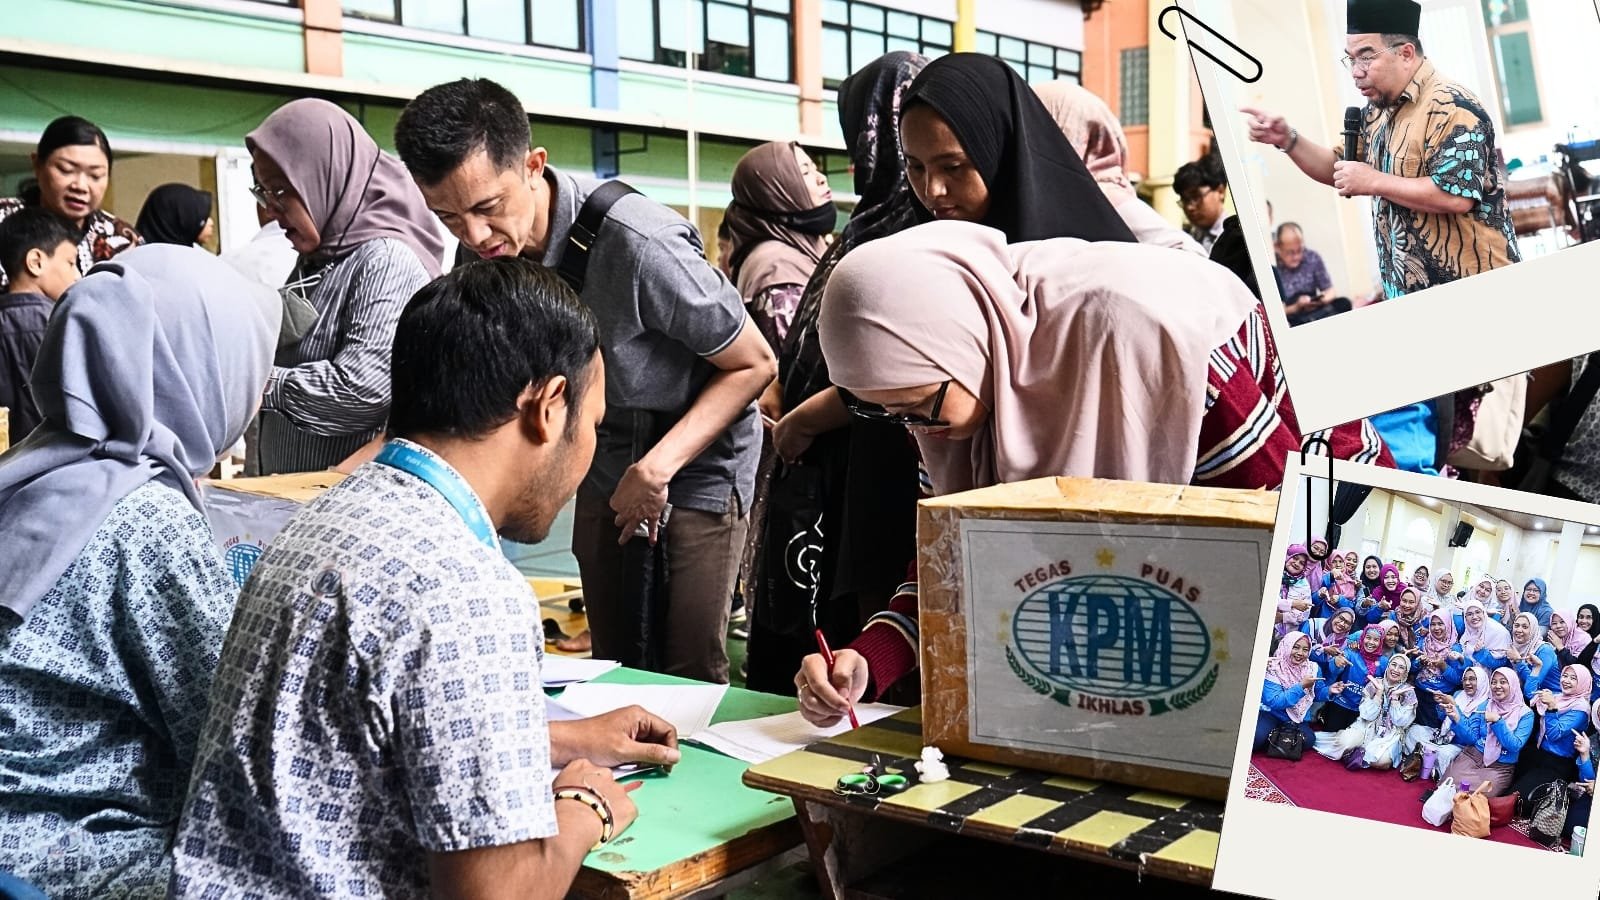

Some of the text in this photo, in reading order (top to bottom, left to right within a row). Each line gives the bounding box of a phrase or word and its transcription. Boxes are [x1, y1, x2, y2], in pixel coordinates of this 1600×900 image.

[1014, 560, 1201, 603] TEGAS PUAS
[1047, 591, 1172, 689] KPM
[1077, 694, 1145, 717] IKHLAS
